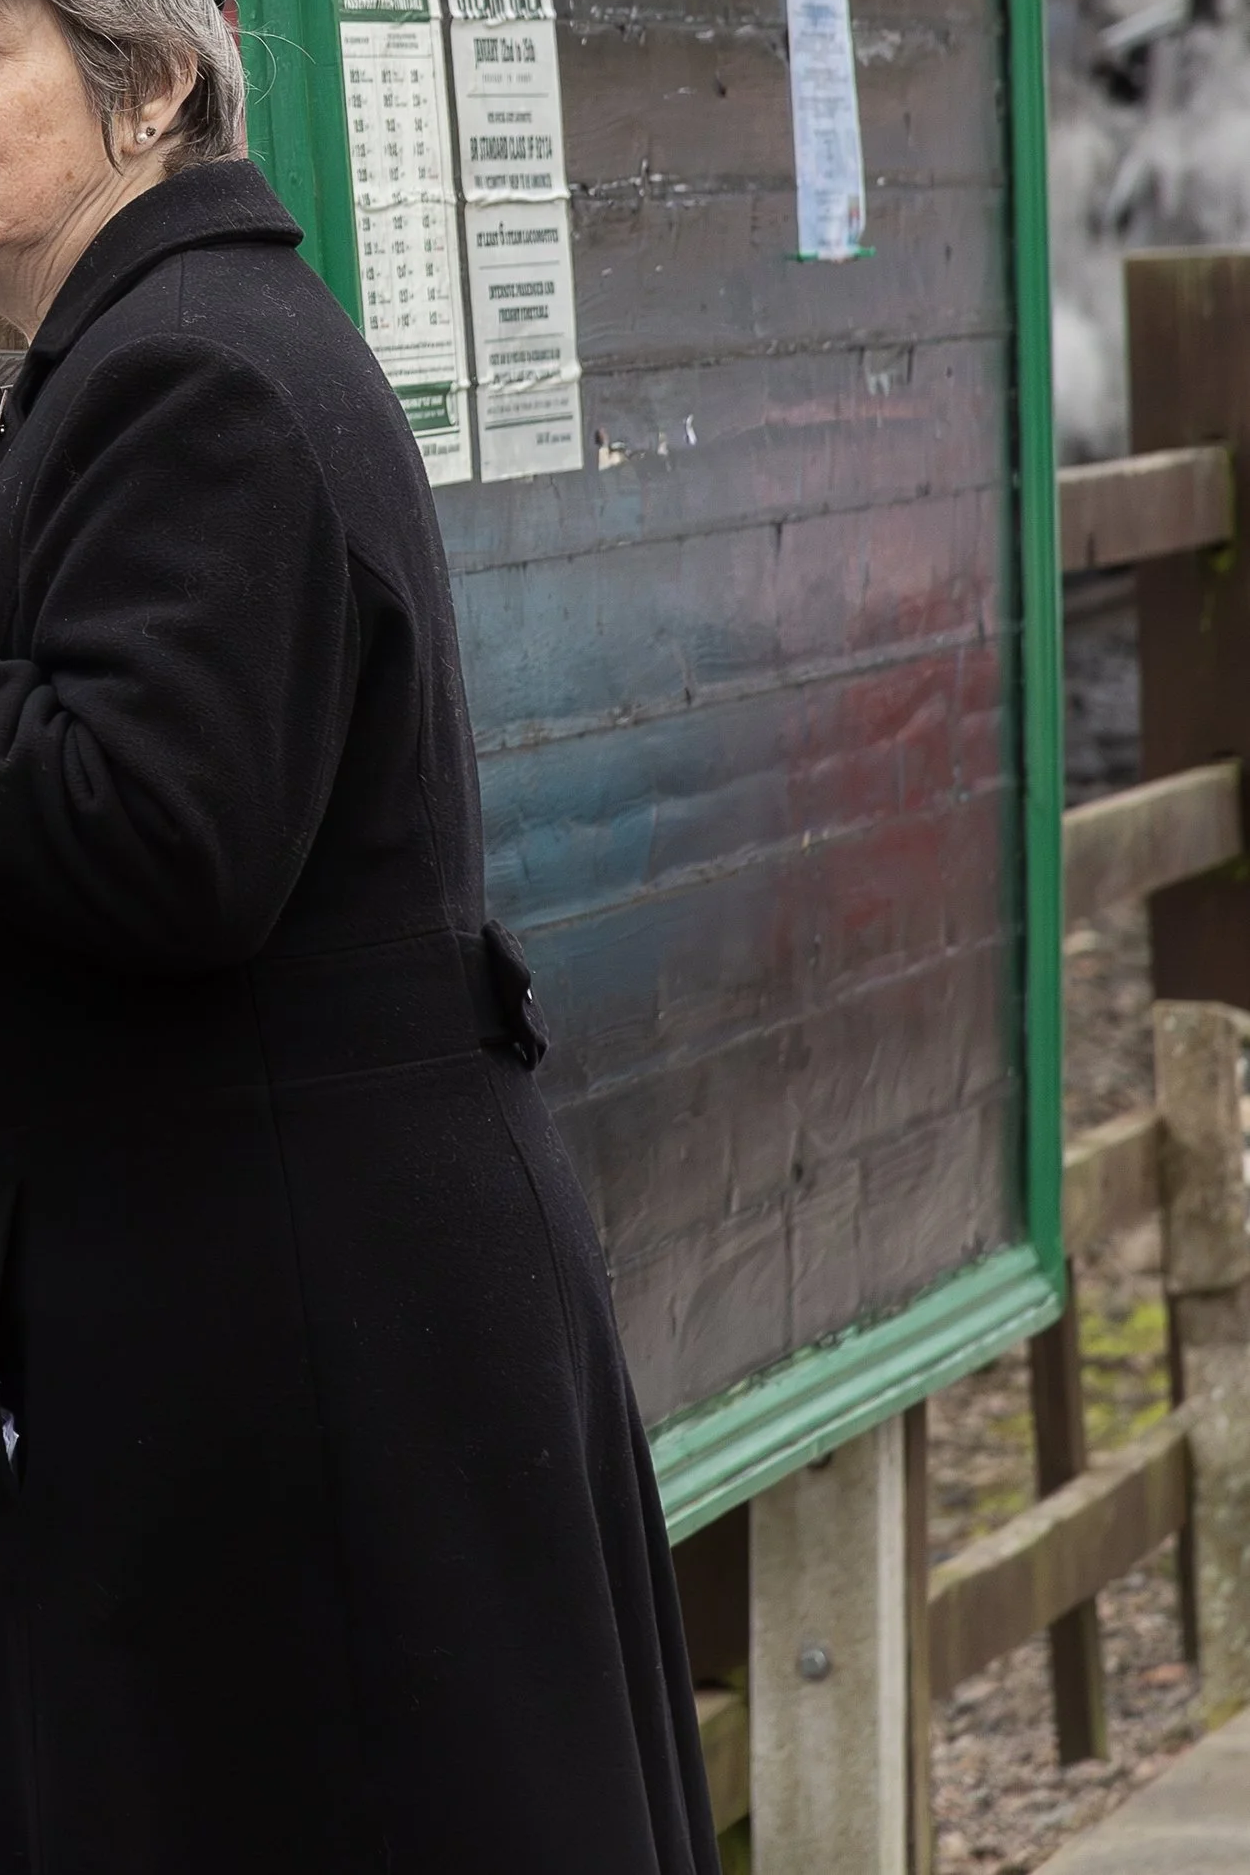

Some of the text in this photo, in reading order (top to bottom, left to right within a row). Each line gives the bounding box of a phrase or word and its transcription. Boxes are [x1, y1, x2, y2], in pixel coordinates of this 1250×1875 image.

[473, 37, 499, 69] JANUARY
[480, 136, 508, 161] STANDARD
[509, 135, 526, 160] CLASS
